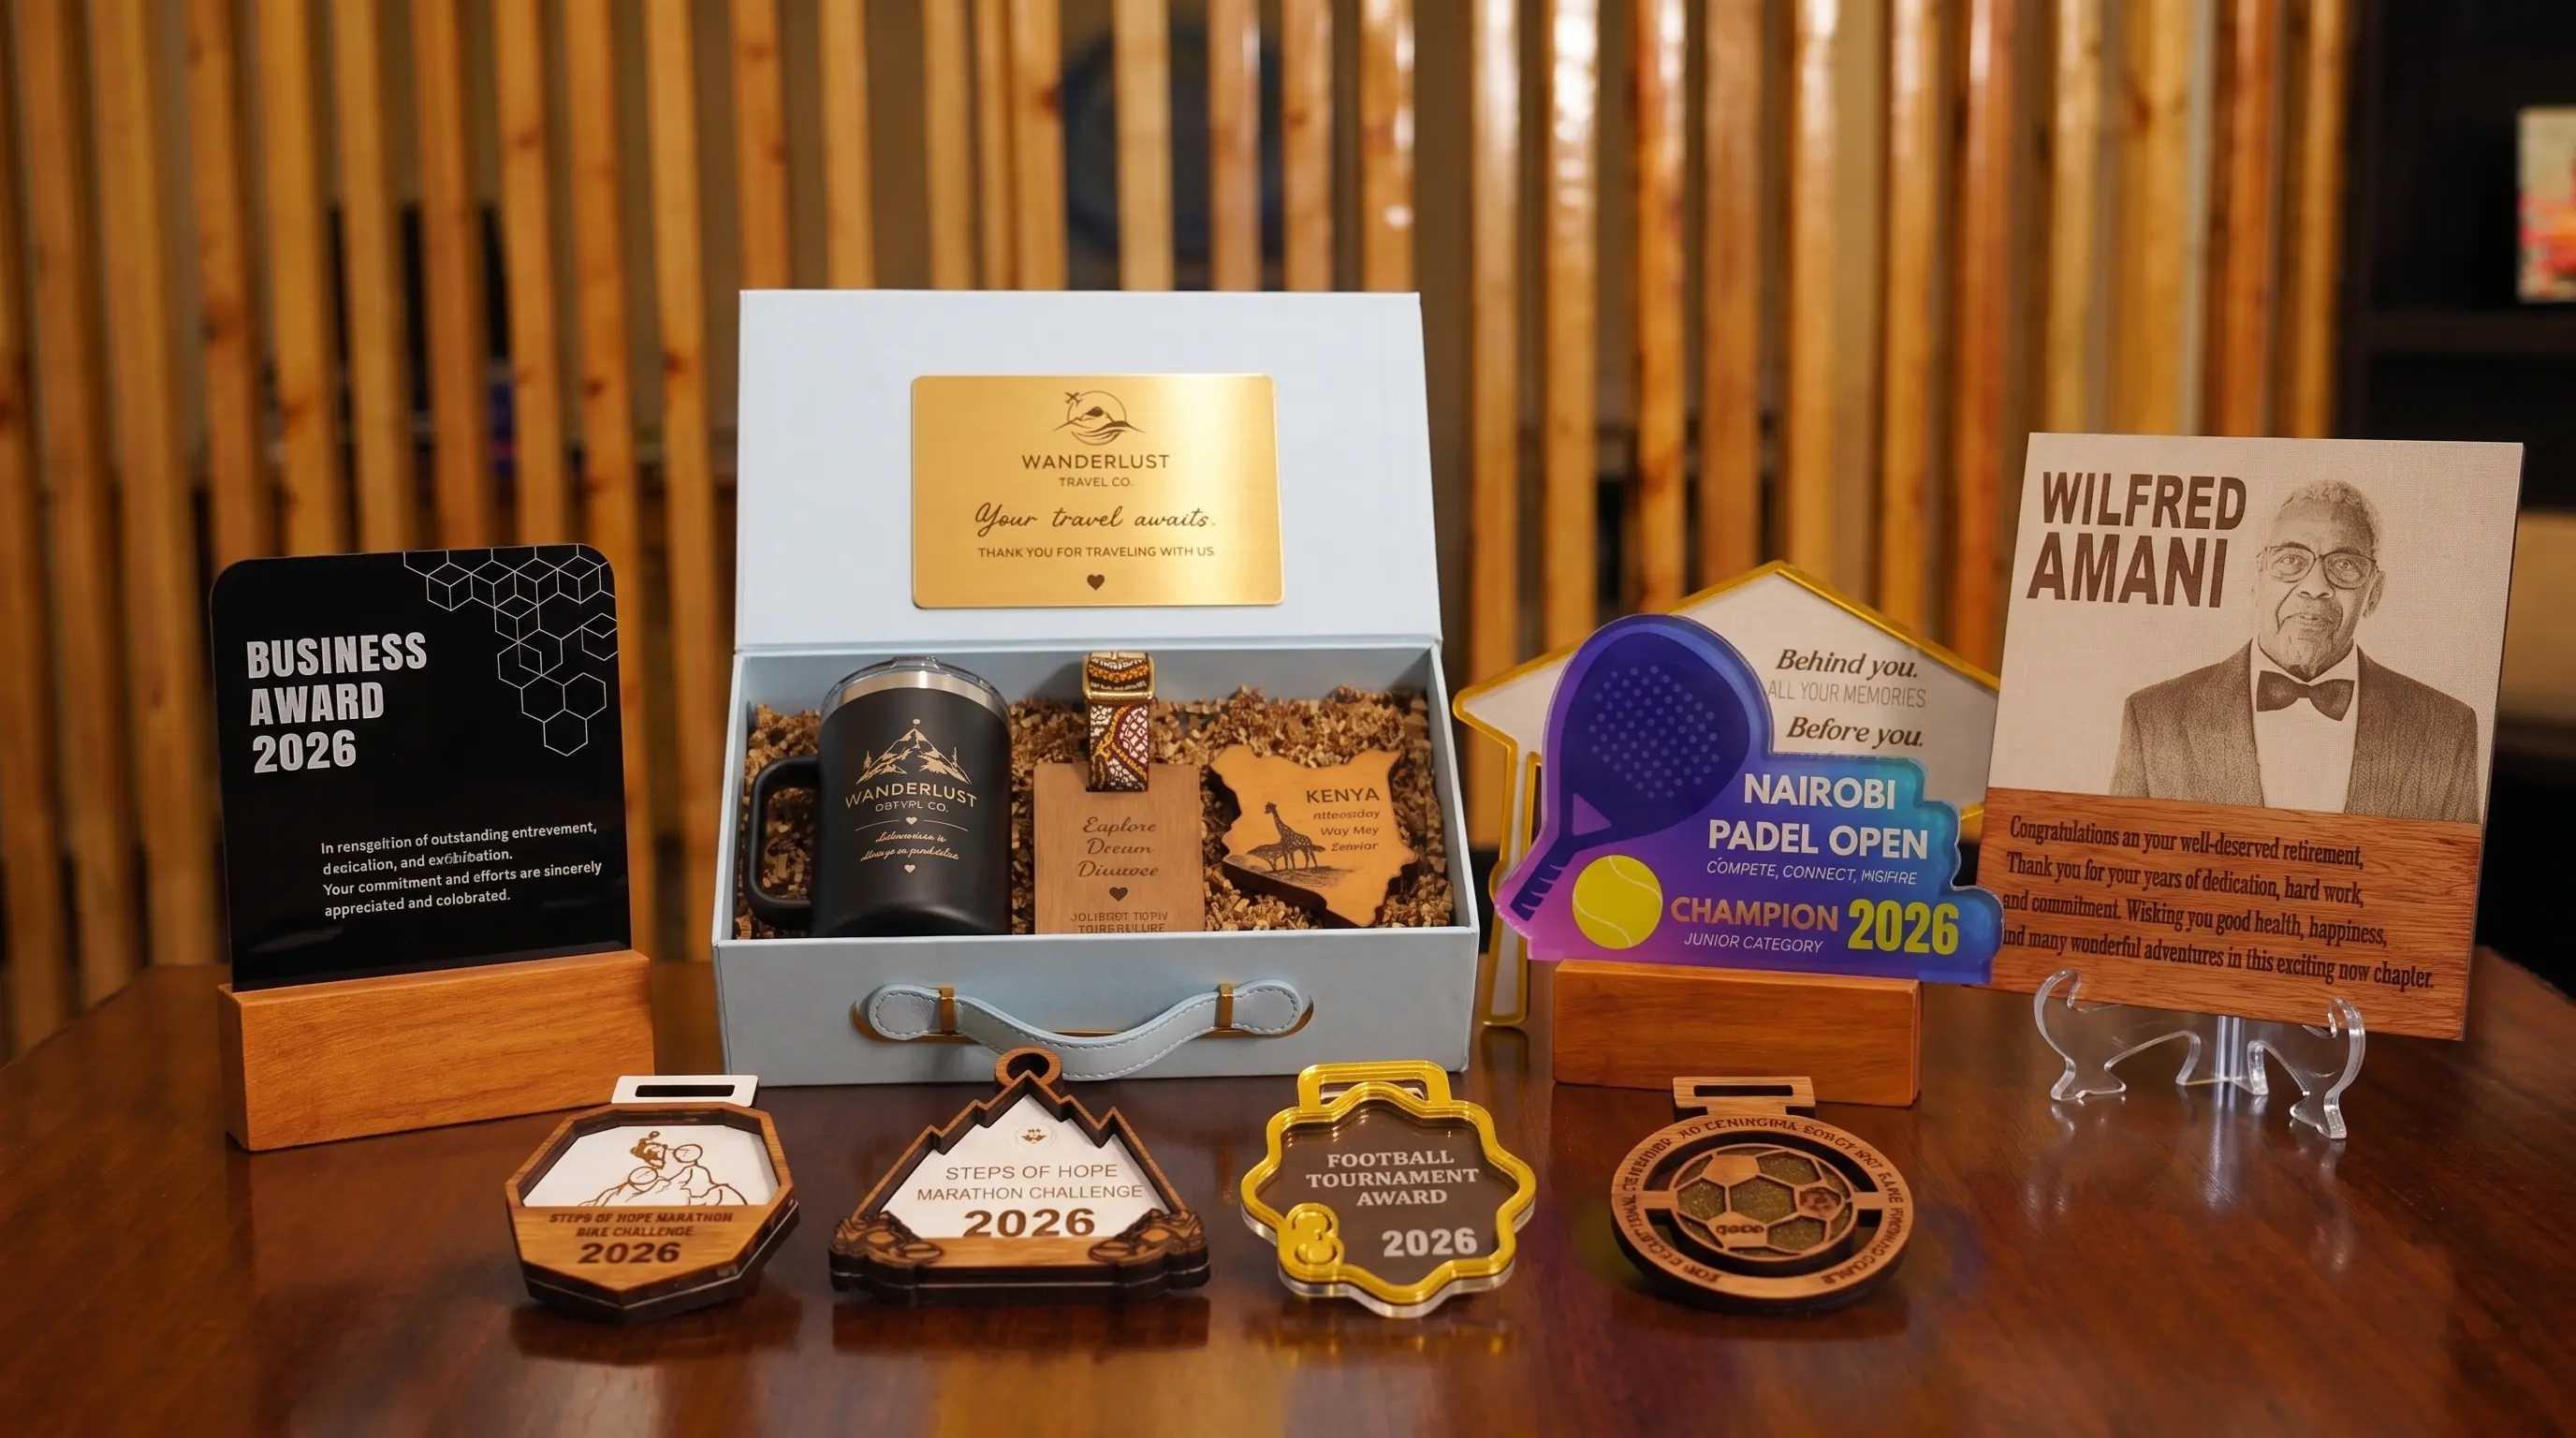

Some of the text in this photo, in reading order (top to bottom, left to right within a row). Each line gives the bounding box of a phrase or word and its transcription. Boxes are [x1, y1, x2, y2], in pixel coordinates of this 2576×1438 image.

[1021, 454, 1170, 470] WANDERLUST
[1059, 477, 1134, 487] TRAVEL CO.
[2042, 471, 2247, 531] WILFRED
[974, 502, 1216, 537] Your travel awaits.
[978, 548, 1023, 558] THANK
[1026, 548, 1053, 558] YOU
[1057, 547, 1082, 558] FOR
[1086, 547, 1156, 558] TRAVELING
[1160, 546, 1193, 557] WITH
[2027, 532, 2228, 609] AMANI
[246, 632, 427, 679] BUSINESS
[1776, 649, 1918, 681] Behind you.
[250, 682, 384, 726] AWARD
[1767, 680, 1926, 709] ALL YOUR MEMORIES
[1786, 716, 1924, 749] Before you.
[252, 729, 357, 773] 2026
[845, 782, 976, 808] WANDERLUST
[1306, 787, 1380, 803] KENYA
[1744, 773, 1895, 810] NAIROBI
[928, 801, 949, 813] CO.
[321, 843, 334, 855] In
[416, 833, 430, 846] of
[431, 829, 509, 846] outstanding
[512, 821, 598, 840] entrevement,
[1321, 827, 1349, 837] Way
[1708, 819, 1928, 859] PADEL OPEN
[2010, 814, 2119, 846] Congratulations
[2142, 831, 2178, 855] your
[2180, 830, 2280, 859] well-deserved
[2282, 840, 2364, 871] retirement,
[401, 855, 426, 870] and
[1706, 858, 1778, 879] COMPETE,
[1782, 865, 1857, 884] CONNECT,
[323, 860, 602, 897] Your commitment and efforts are sincerely
[2006, 851, 2364, 908] Thank you for your years of dedication, hard work,
[325, 896, 404, 919] appreciated
[408, 894, 432, 909] and
[2003, 889, 2028, 911] and
[2031, 895, 2121, 920] commitment.
[2186, 910, 2214, 933] you
[2216, 909, 2252, 936] good
[2254, 910, 2305, 941] health,
[2308, 916, 2387, 948] happiness,
[1670, 896, 1959, 955] CHAMPION 2026
[1684, 932, 1823, 953] JUNIOR CATEGORY
[2028, 931, 2068, 957] many
[2071, 933, 2142, 960] wonderful
[2144, 939, 2224, 967] adventures
[2227, 946, 2242, 968] in
[2247, 947, 2274, 973] this
[2276, 952, 2336, 986] exciting
[945, 1164, 1118, 1181] STEPS OF HOPE
[1326, 1150, 1455, 1168] FOOTBALL
[1306, 1168, 1480, 1188] TOURNAMENT
[917, 1185, 1143, 1201] MARATHON CHALLENGE
[1356, 1189, 1448, 1207] AWARD
[549, 1212, 592, 1224] STEPS
[616, 1212, 653, 1224] HOPE
[655, 1211, 734, 1224] MARATHON
[576, 1225, 694, 1238] BIKE CHALLENGE
[962, 1208, 1095, 1238] 2026
[577, 1241, 681, 1265] 2026
[1382, 1227, 1479, 1257] 2026
